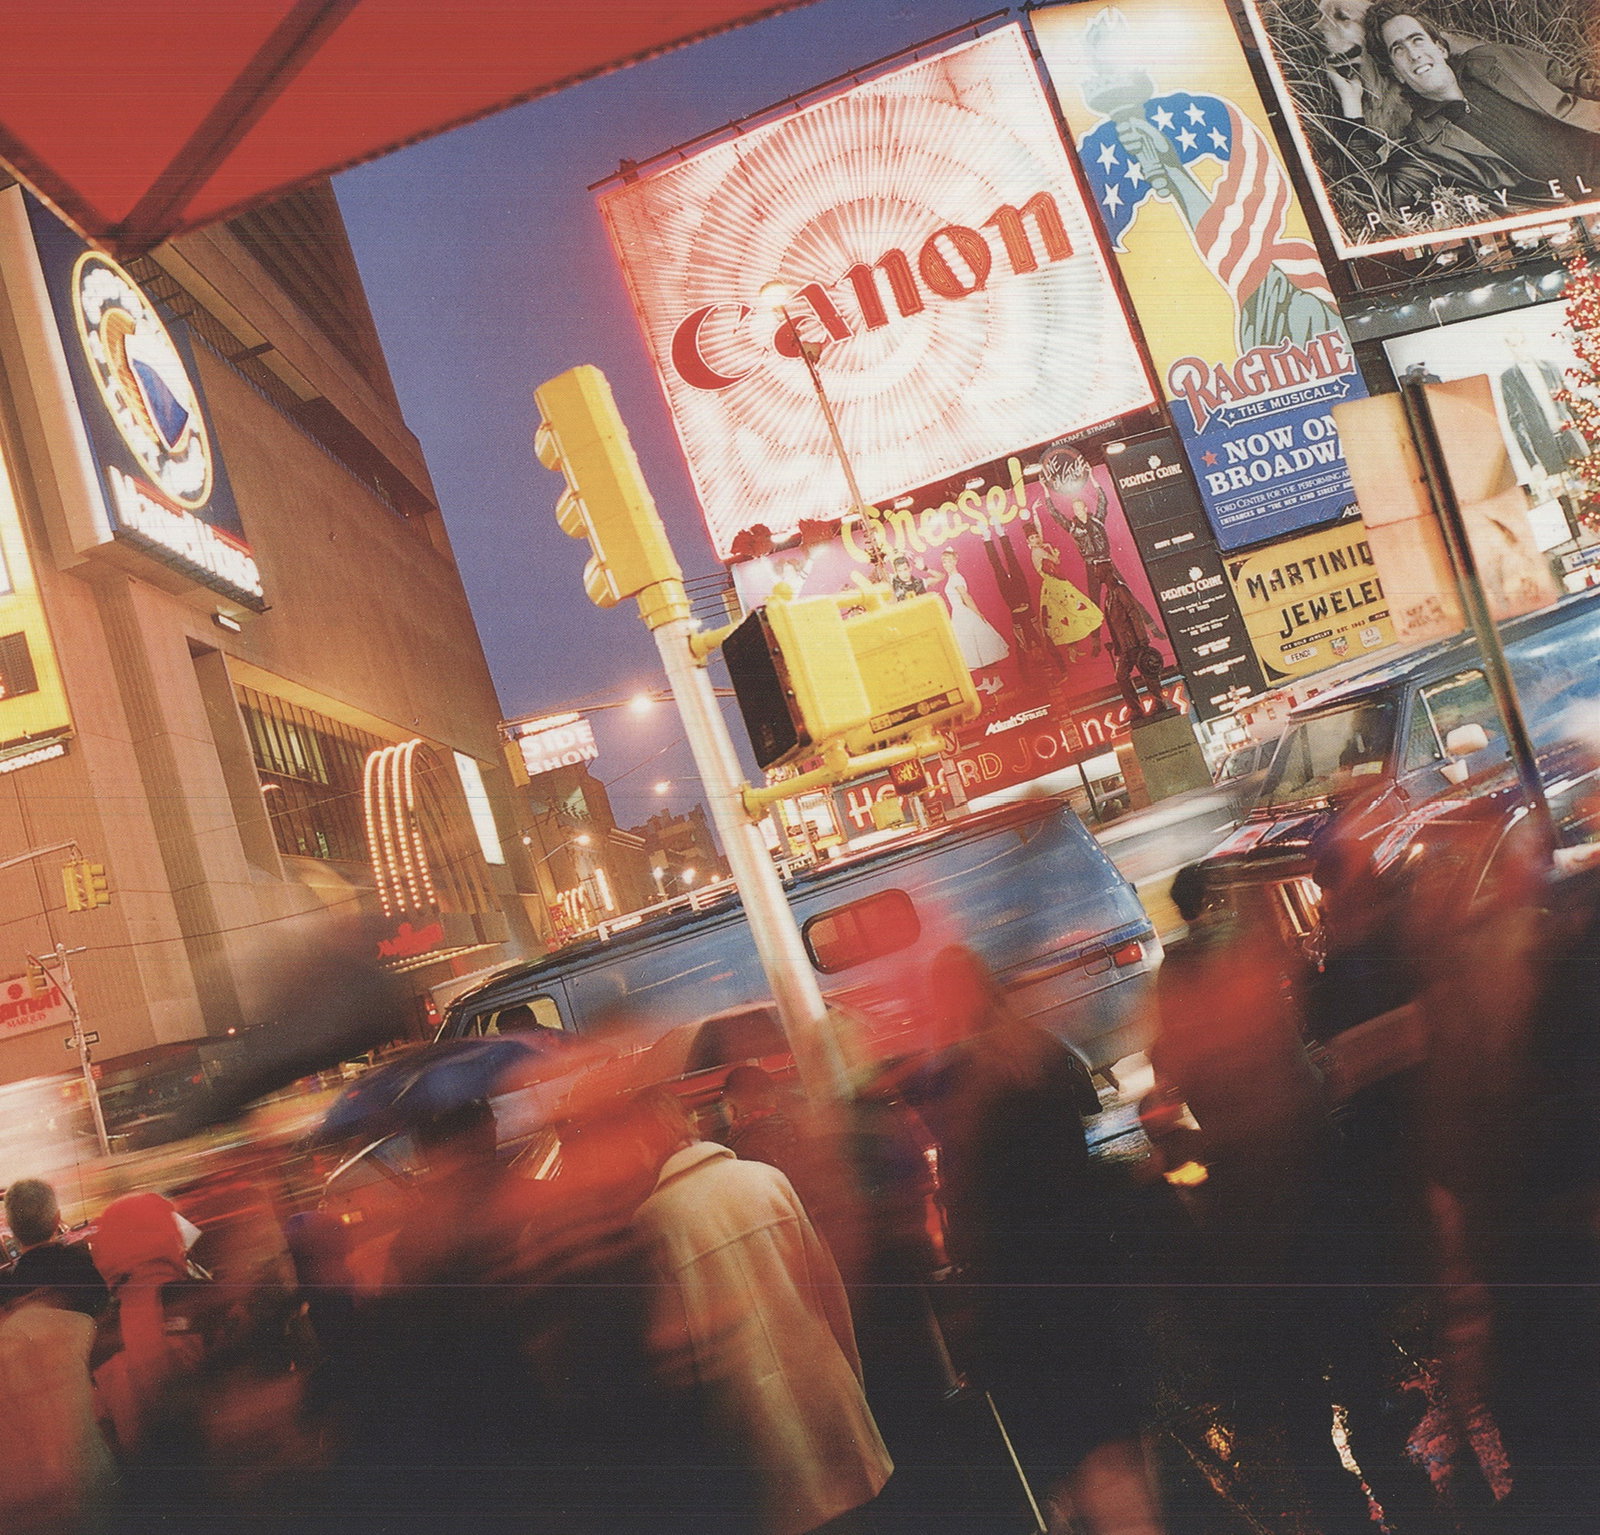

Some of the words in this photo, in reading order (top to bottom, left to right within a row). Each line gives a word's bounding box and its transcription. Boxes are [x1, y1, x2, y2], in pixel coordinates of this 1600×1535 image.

[1366, 188, 1508, 231] PERRY
[670, 190, 1074, 391] Canon
[1167, 328, 1356, 435] RAGTIME
[1238, 403, 1265, 418] THE
[1269, 386, 1332, 410] MUSICAL
[1051, 431, 1084, 447] ARTKRAFT
[1087, 420, 1116, 435] STRAUSS
[1222, 425, 1294, 465] NOW
[1215, 503, 1237, 515] FORD
[1237, 494, 1266, 510] CENTER
[1266, 489, 1282, 501] FOR
[1282, 484, 1297, 496] THE
[1298, 472, 1342, 491] PERFORMING
[1290, 648, 1311, 662] FENDI
[526, 744, 599, 776] SHOW
